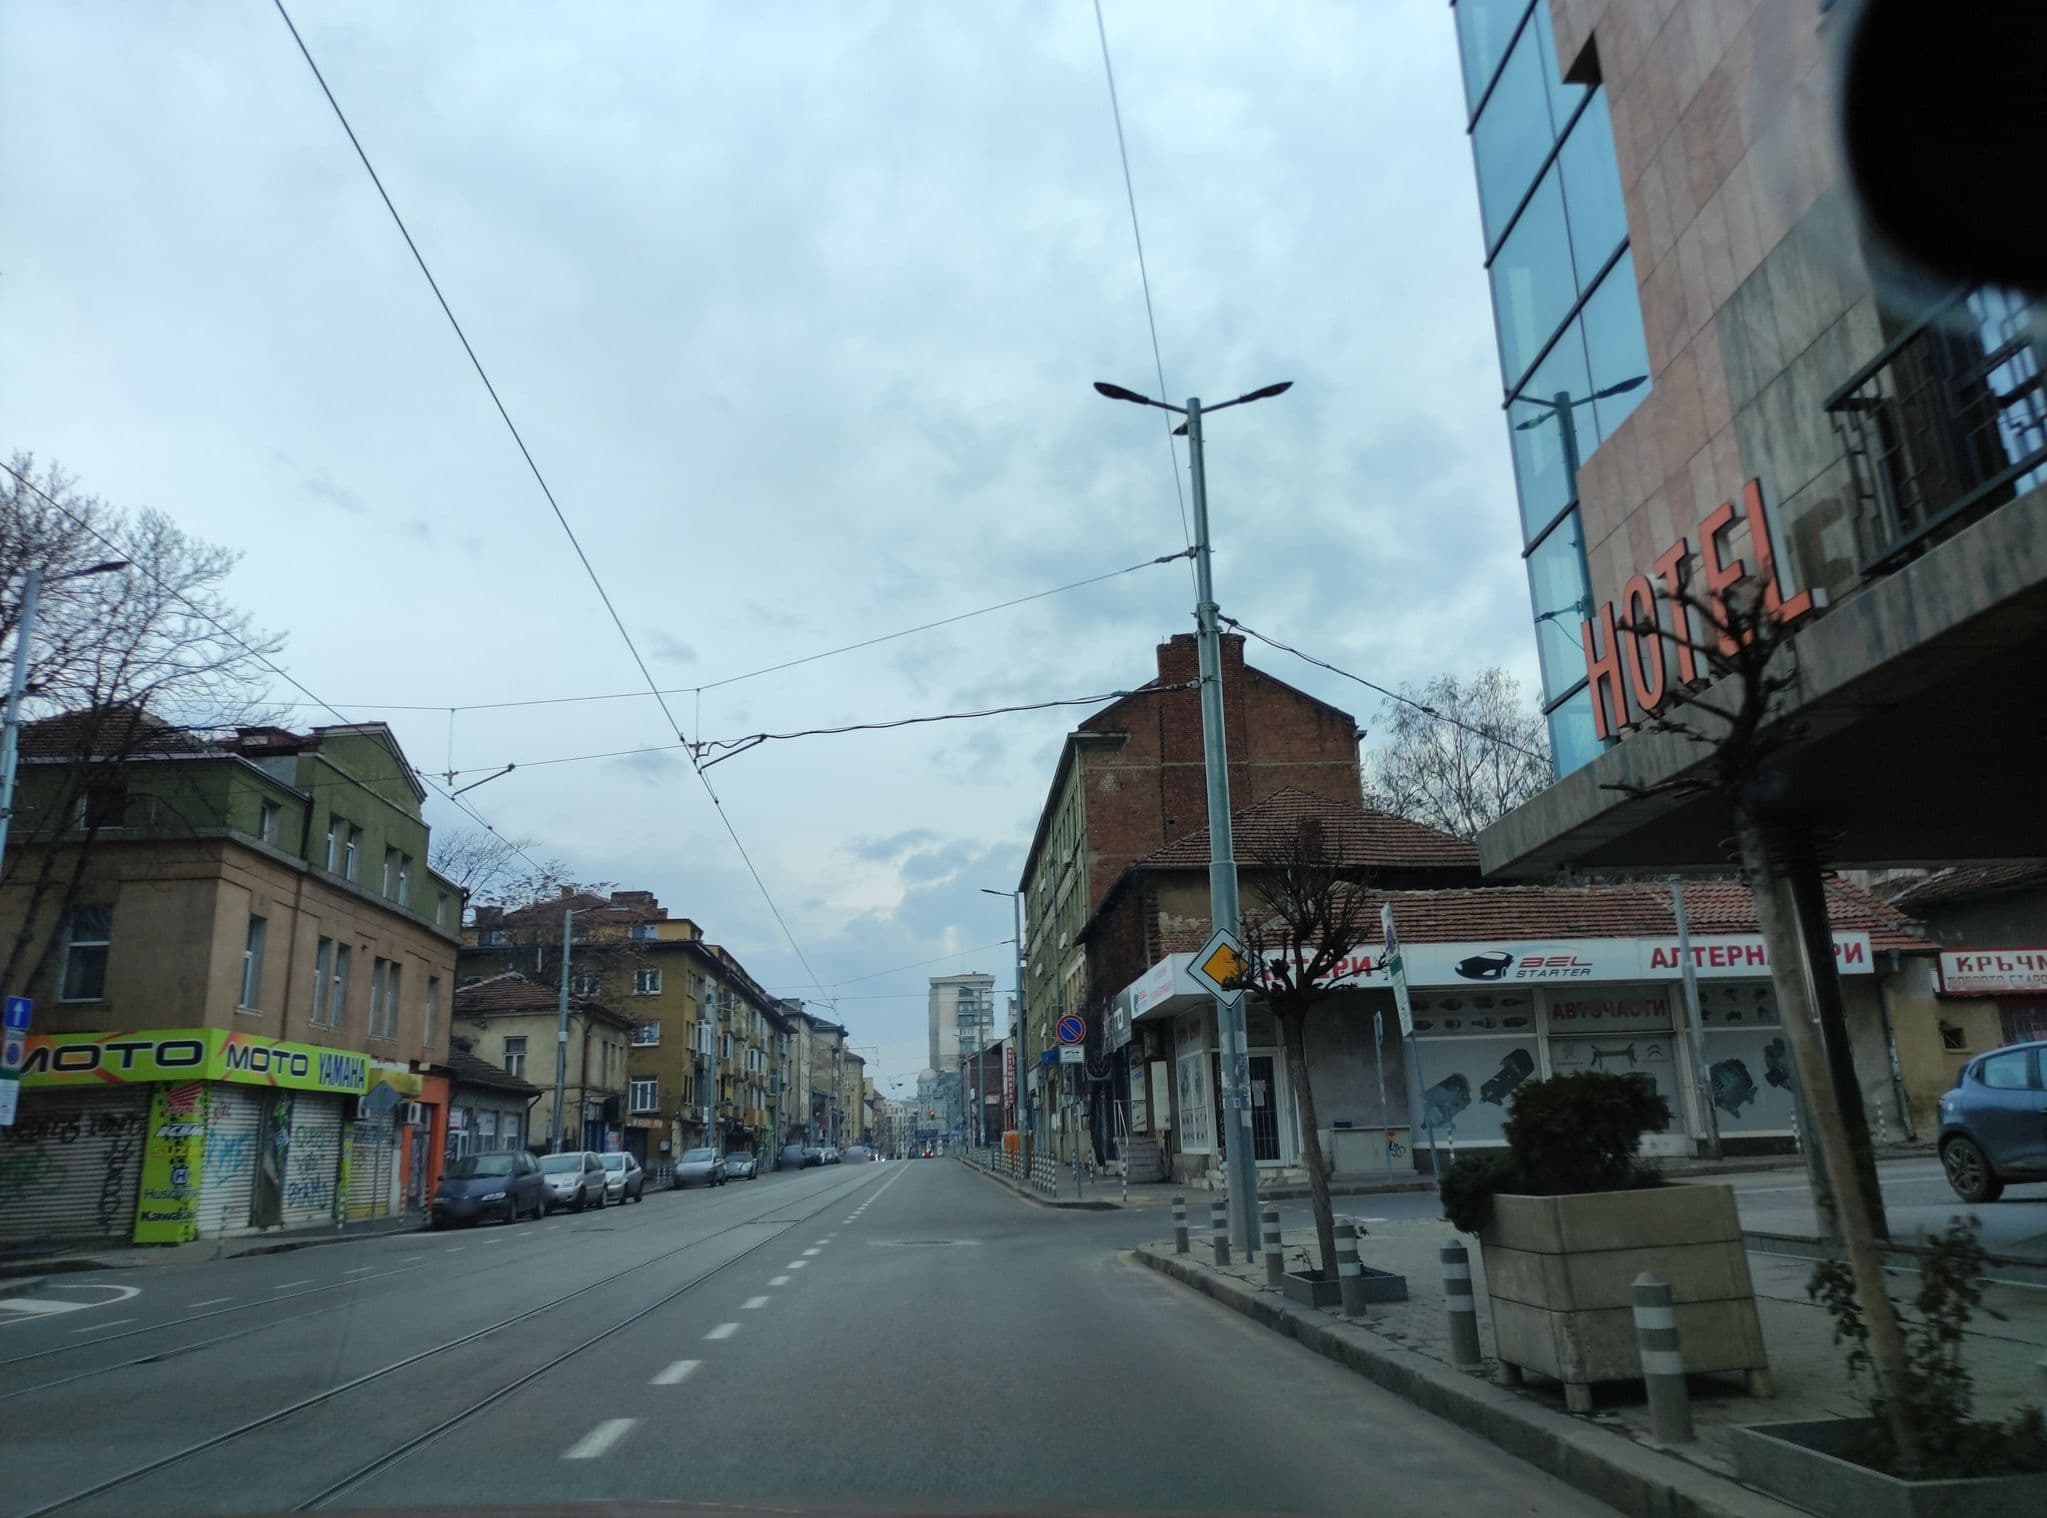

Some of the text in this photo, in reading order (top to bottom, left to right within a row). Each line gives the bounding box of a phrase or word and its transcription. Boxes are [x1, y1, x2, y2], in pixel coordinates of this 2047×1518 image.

[1581, 477, 1816, 741] HOTEL
[1515, 968, 1592, 979] STARTER
[1518, 956, 1593, 969] BEL
[226, 1043, 309, 1077] MOTO
[319, 1052, 366, 1089] YAMAHA
